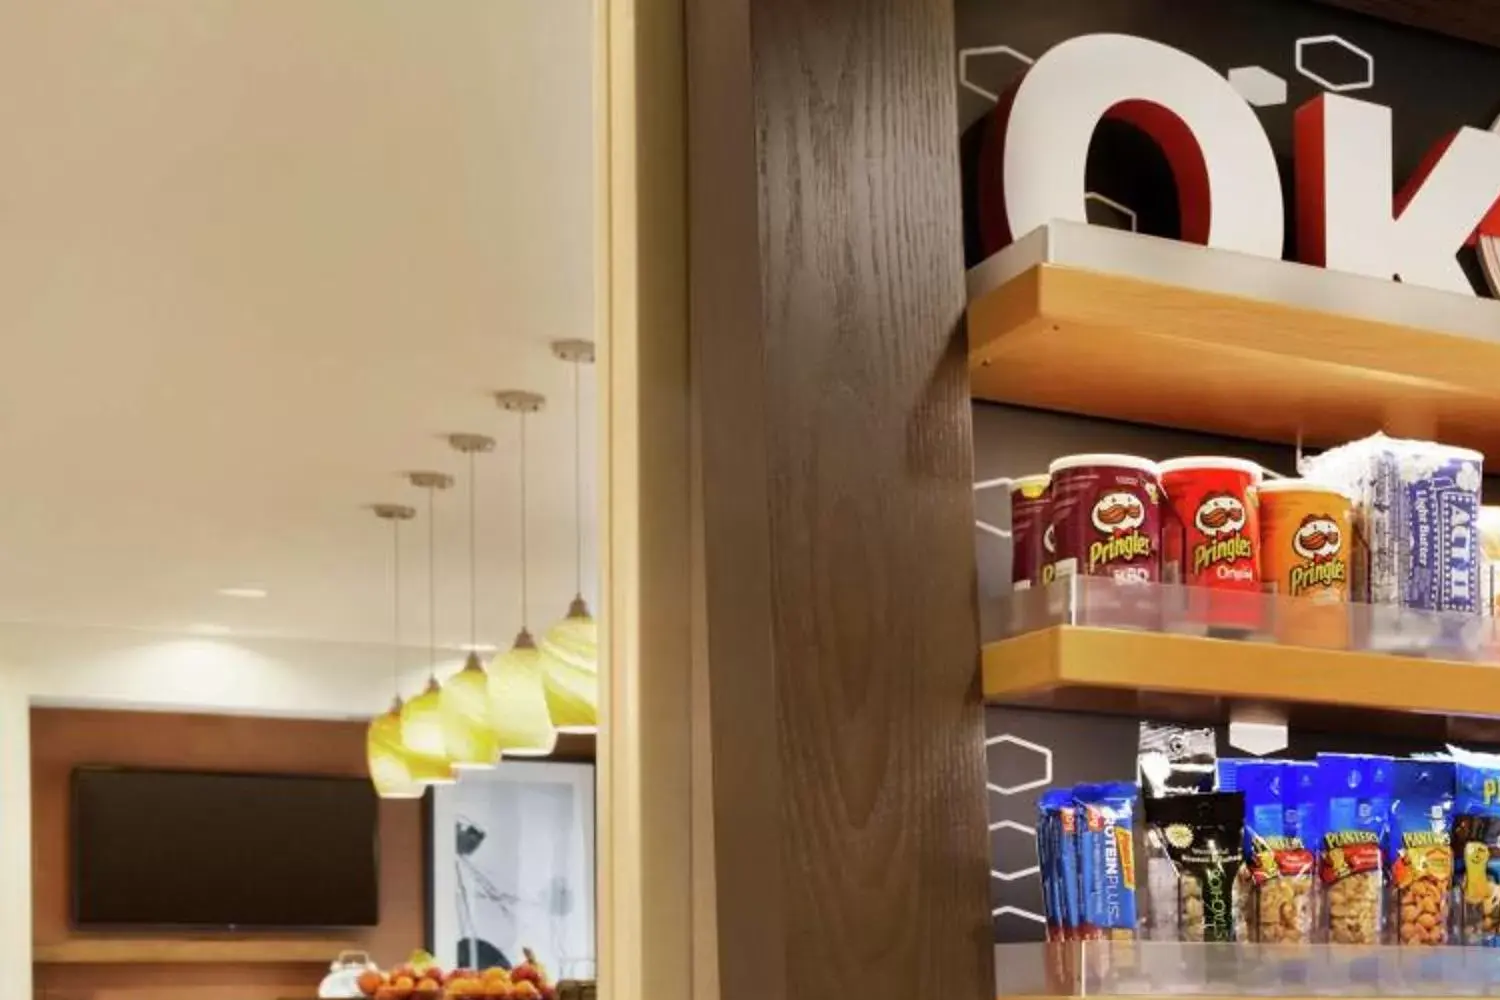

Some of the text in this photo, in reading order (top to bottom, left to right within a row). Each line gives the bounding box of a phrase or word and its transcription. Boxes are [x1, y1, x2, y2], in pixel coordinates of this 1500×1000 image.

[1194, 535, 1252, 577] Pringles
[1418, 524, 1431, 568] Butter
[1450, 503, 1471, 565] ACT
